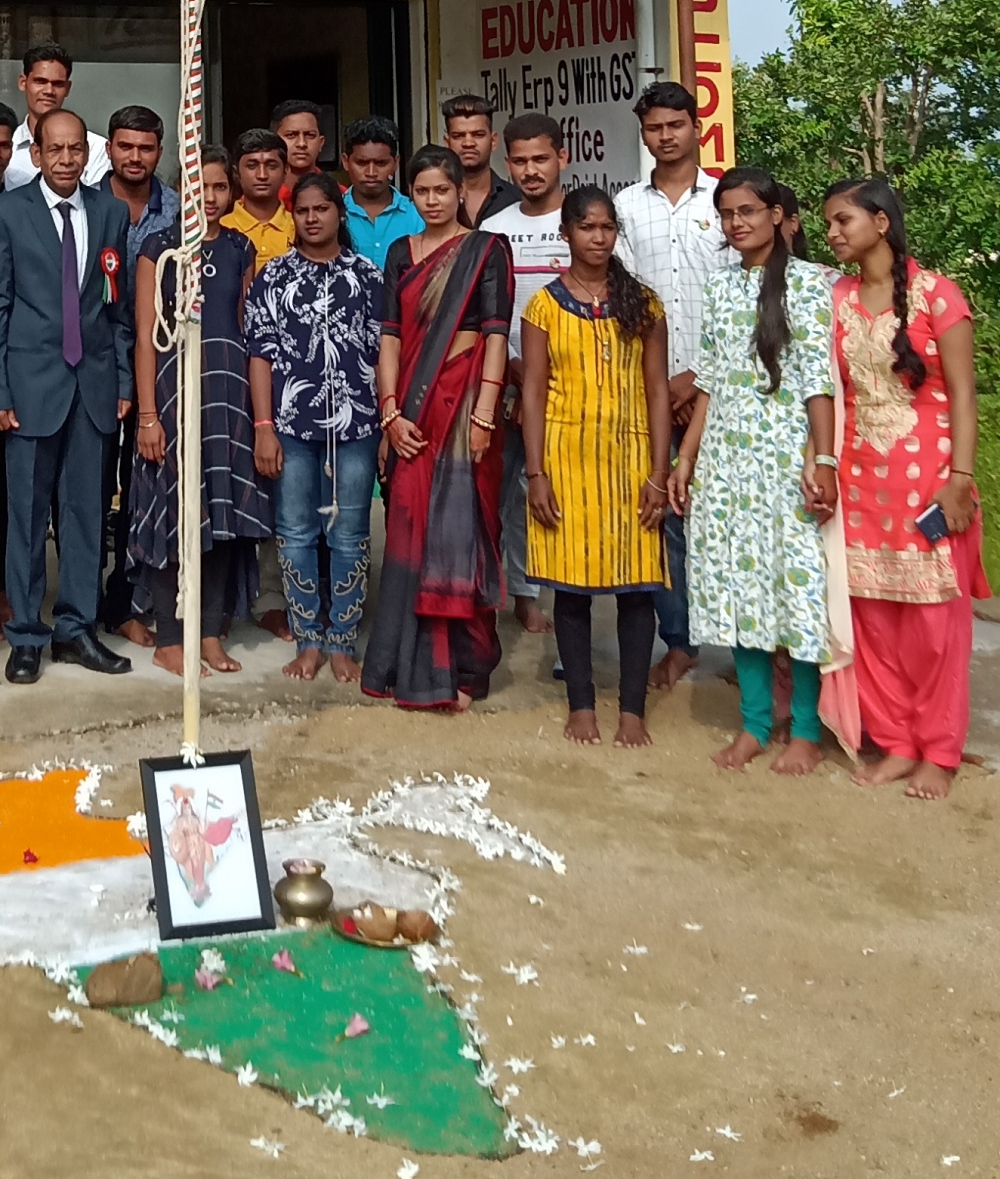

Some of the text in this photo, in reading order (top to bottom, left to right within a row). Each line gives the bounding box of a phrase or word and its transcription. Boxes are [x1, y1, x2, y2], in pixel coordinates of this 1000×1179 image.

[481, 51, 636, 120] Tally Erp 9 With GS
